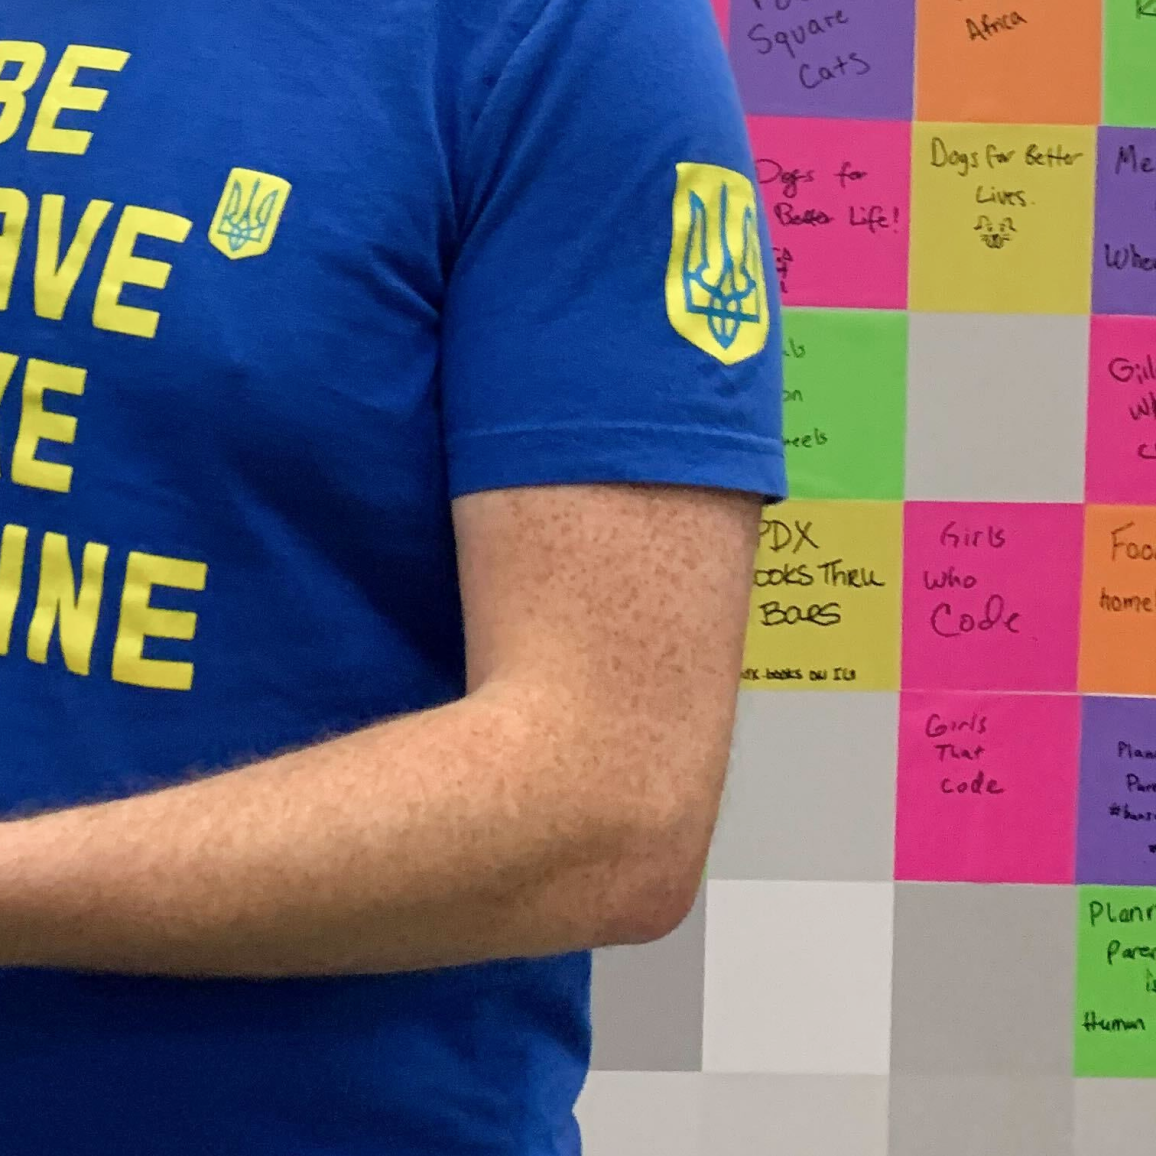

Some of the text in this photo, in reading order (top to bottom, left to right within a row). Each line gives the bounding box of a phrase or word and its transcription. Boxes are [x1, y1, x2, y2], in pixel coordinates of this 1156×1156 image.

[748, 9, 850, 59] Square
[965, 10, 1027, 41] Africa
[930, 137, 979, 176] Dogs
[940, 521, 1006, 549] Girls
[1110, 521, 1156, 562] Foo
[1099, 586, 1156, 614] home
[930, 594, 1021, 638] Code
[925, 712, 987, 738] Girls
[1081, 1011, 1146, 1033] Human
